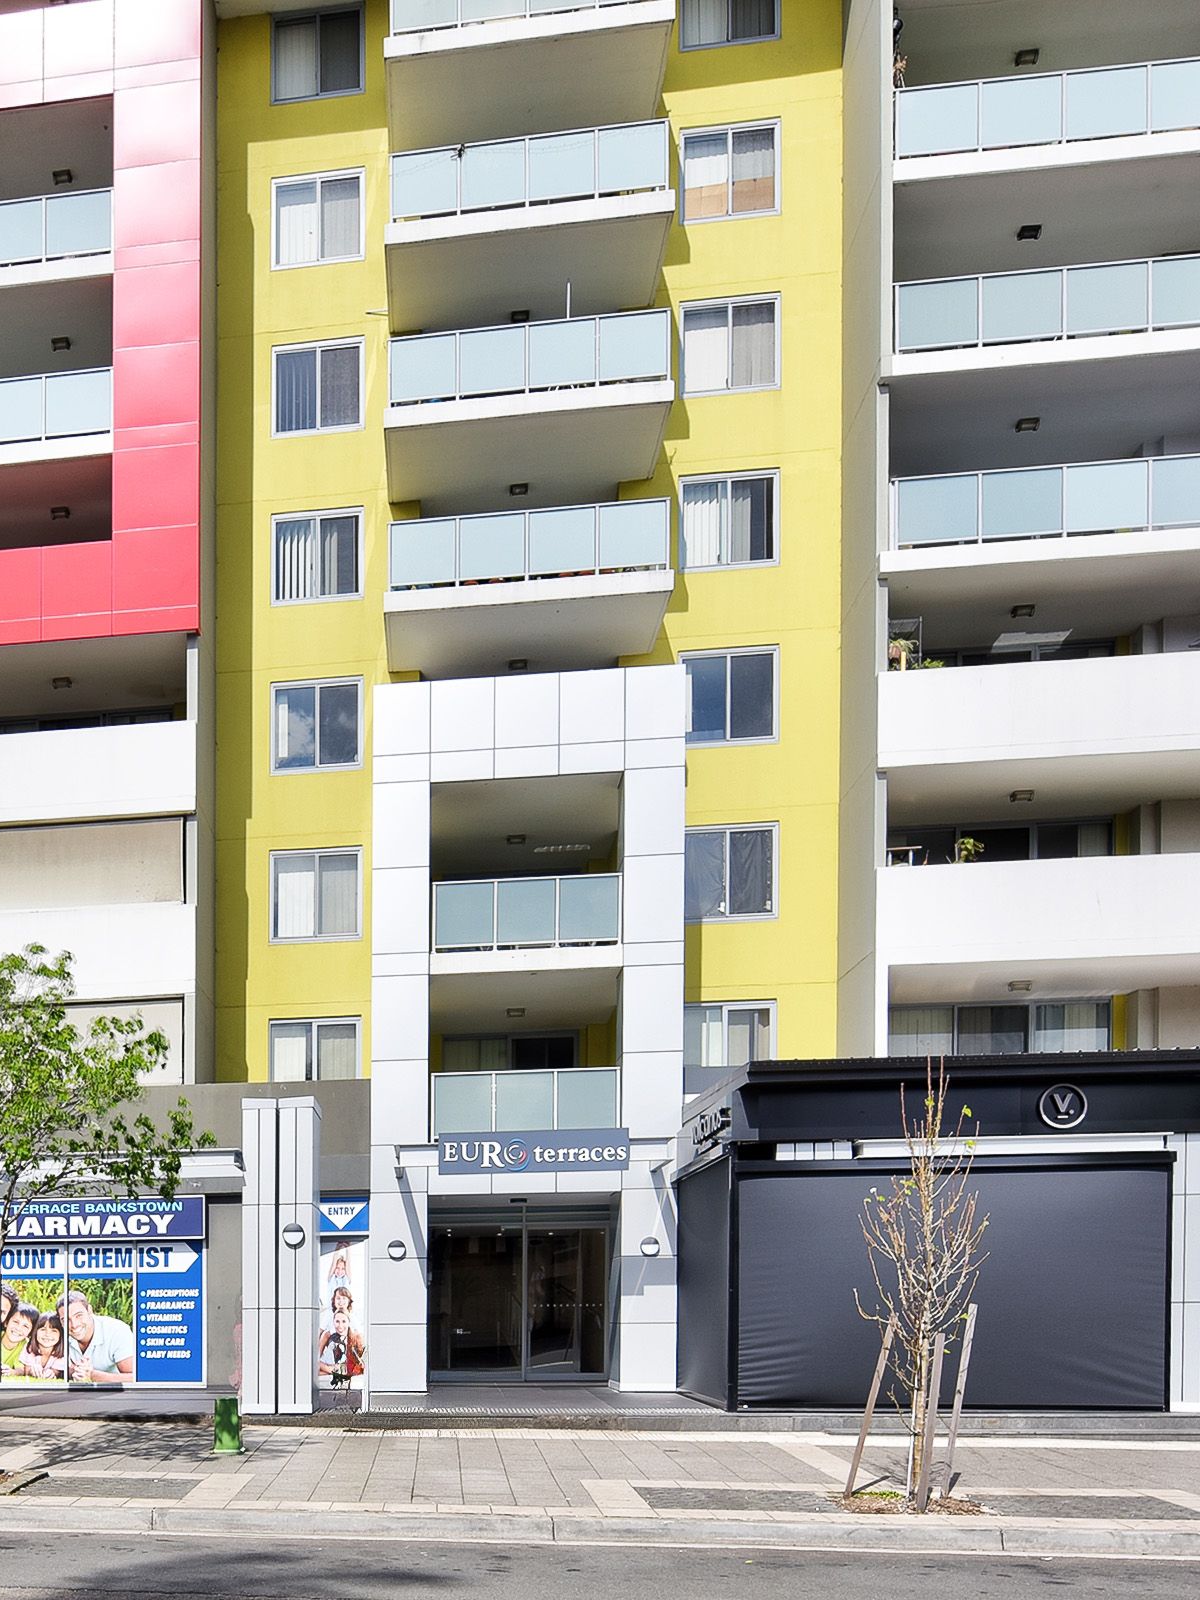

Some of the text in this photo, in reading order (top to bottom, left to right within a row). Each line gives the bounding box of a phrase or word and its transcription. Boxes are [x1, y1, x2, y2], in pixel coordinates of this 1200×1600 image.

[533, 1145, 627, 1163] terraces
[11, 1203, 80, 1215] TERRACE
[85, 1201, 183, 1213] BANKSTOWN
[328, 1206, 356, 1217] ENTRY
[1, 1248, 60, 1270] OUNT
[146, 1288, 200, 1298] PRESCRIPTIONS
[146, 1301, 195, 1310] FRAGRANCES
[146, 1312, 183, 1322] VITAMINS
[146, 1325, 188, 1334] COSMETICS
[146, 1337, 186, 1347] SKIN CARE
[146, 1350, 191, 1359] BABY NEEDS
